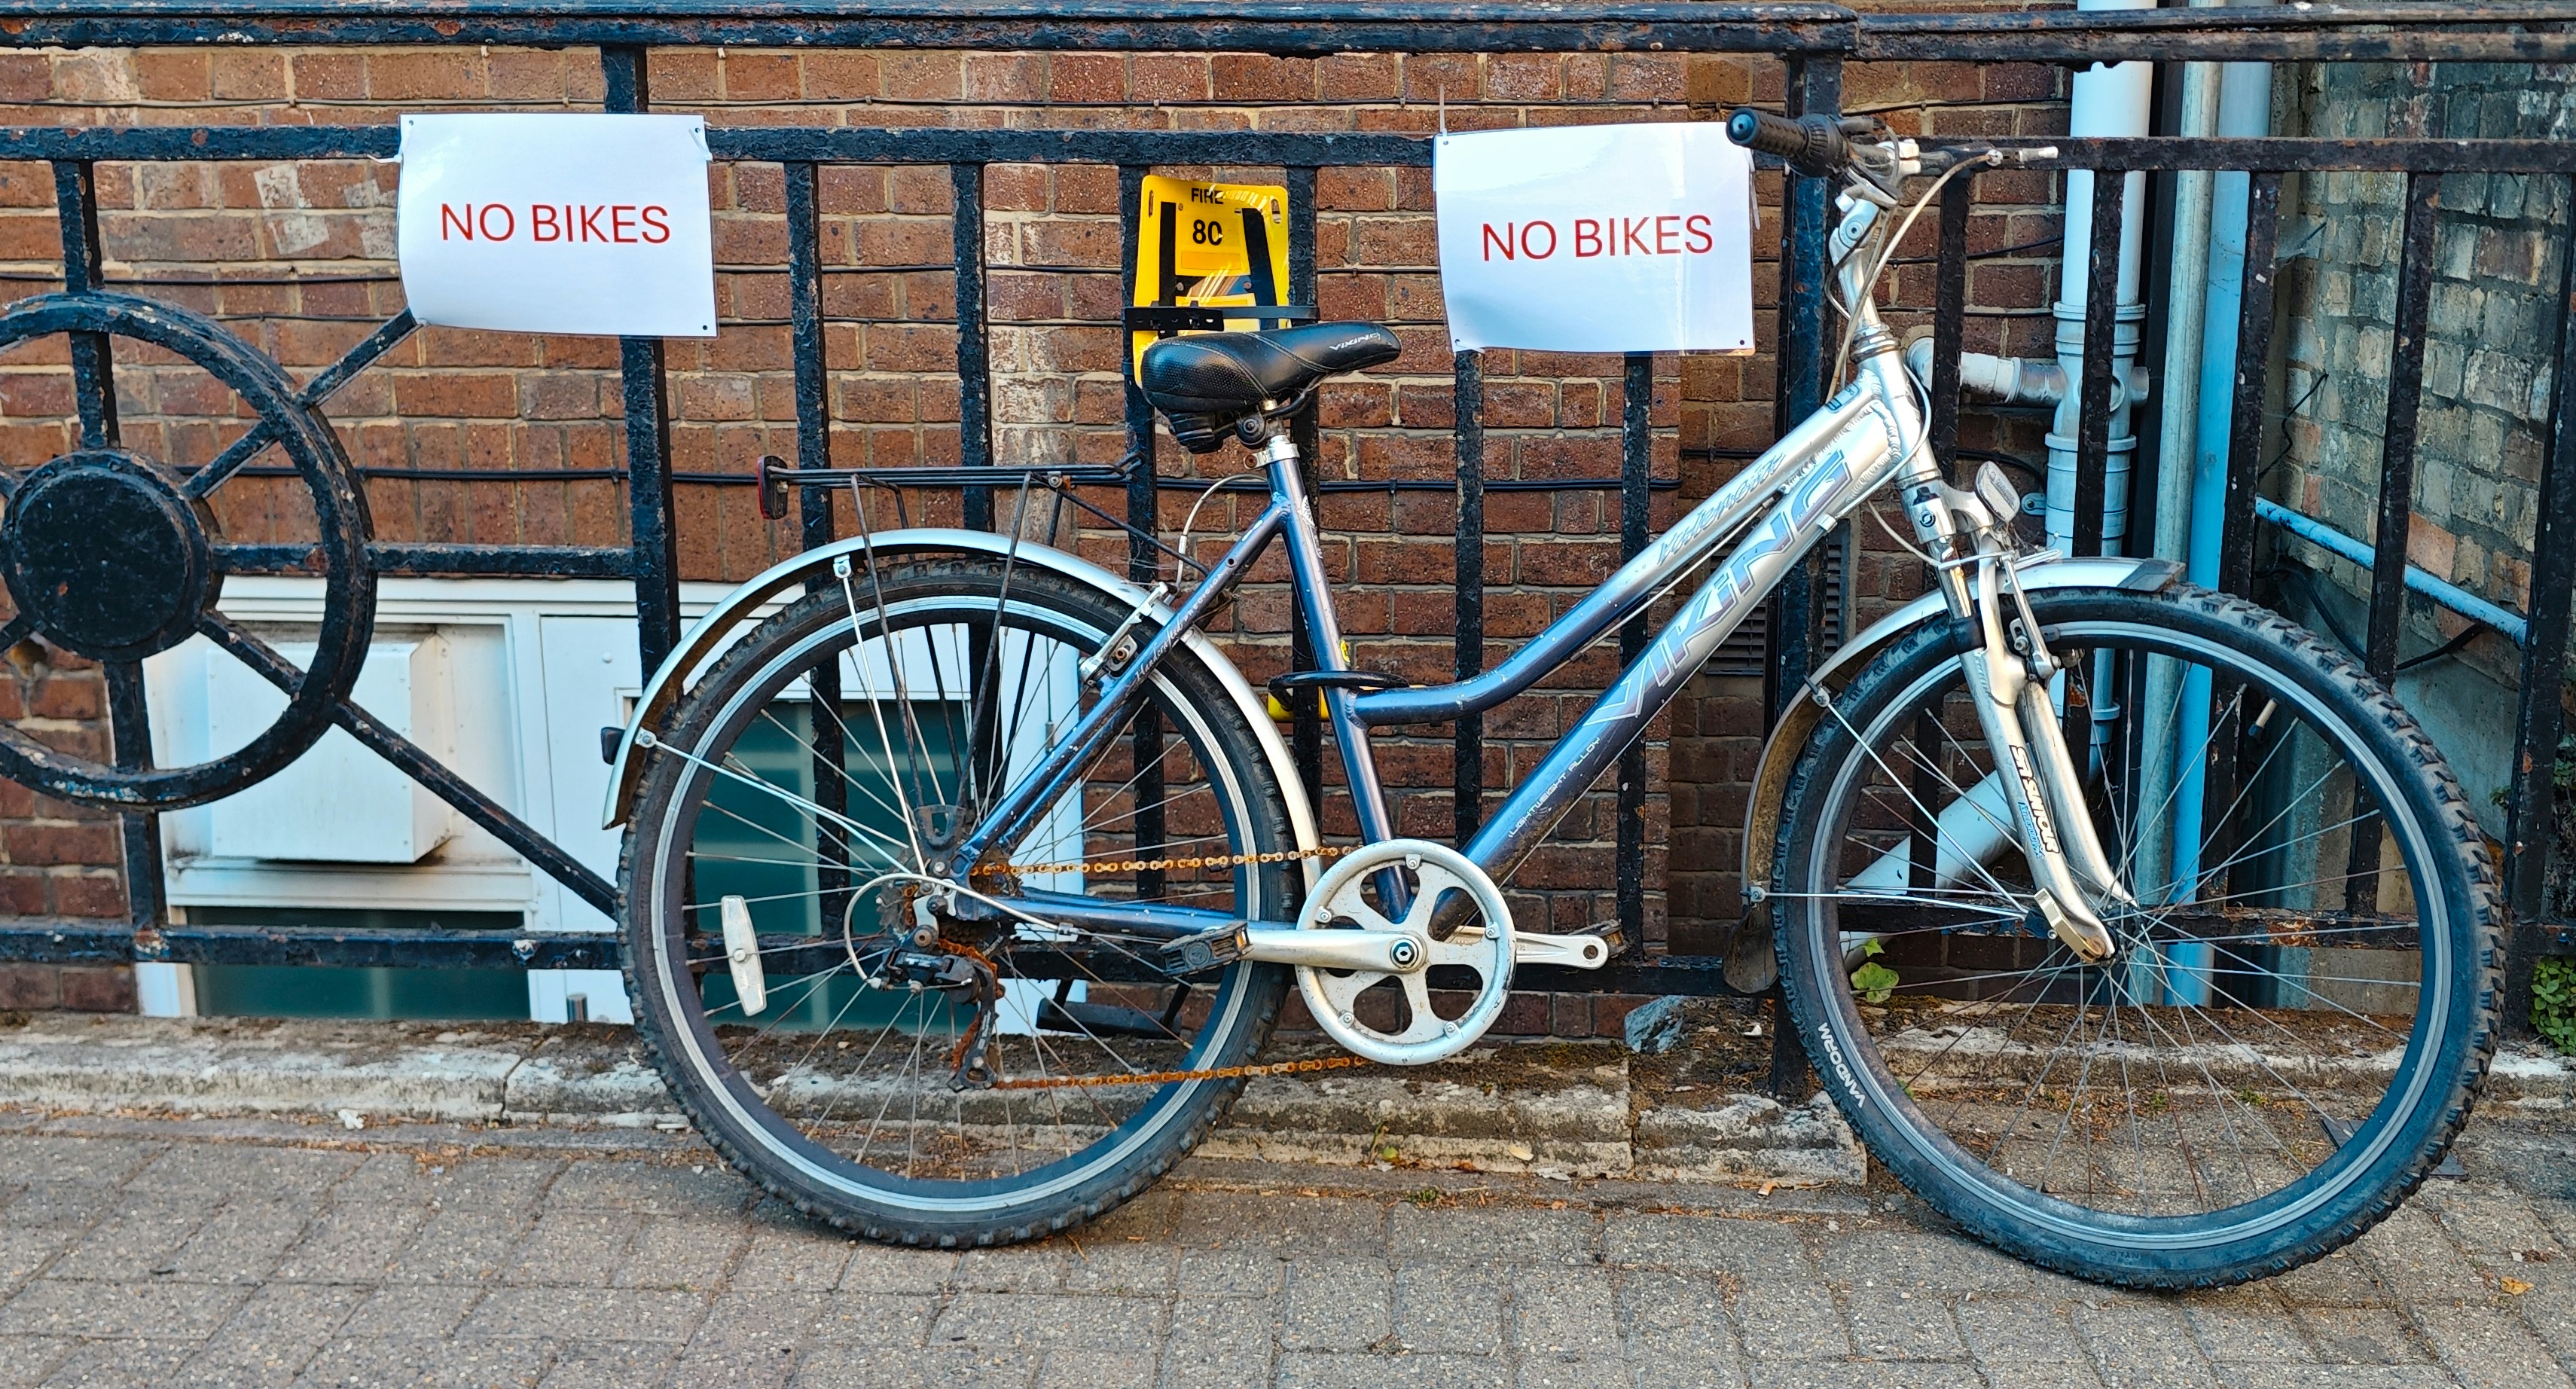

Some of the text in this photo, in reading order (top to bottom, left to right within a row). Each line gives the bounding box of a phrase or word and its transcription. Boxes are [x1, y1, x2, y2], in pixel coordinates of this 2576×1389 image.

[1192, 188, 1224, 204] FIRE
[441, 203, 670, 243] NO BIKES
[1482, 215, 1713, 261] NO BIKES
[1568, 737, 1601, 773] ALLOY
[1818, 1021, 1866, 1110] VANDORM
